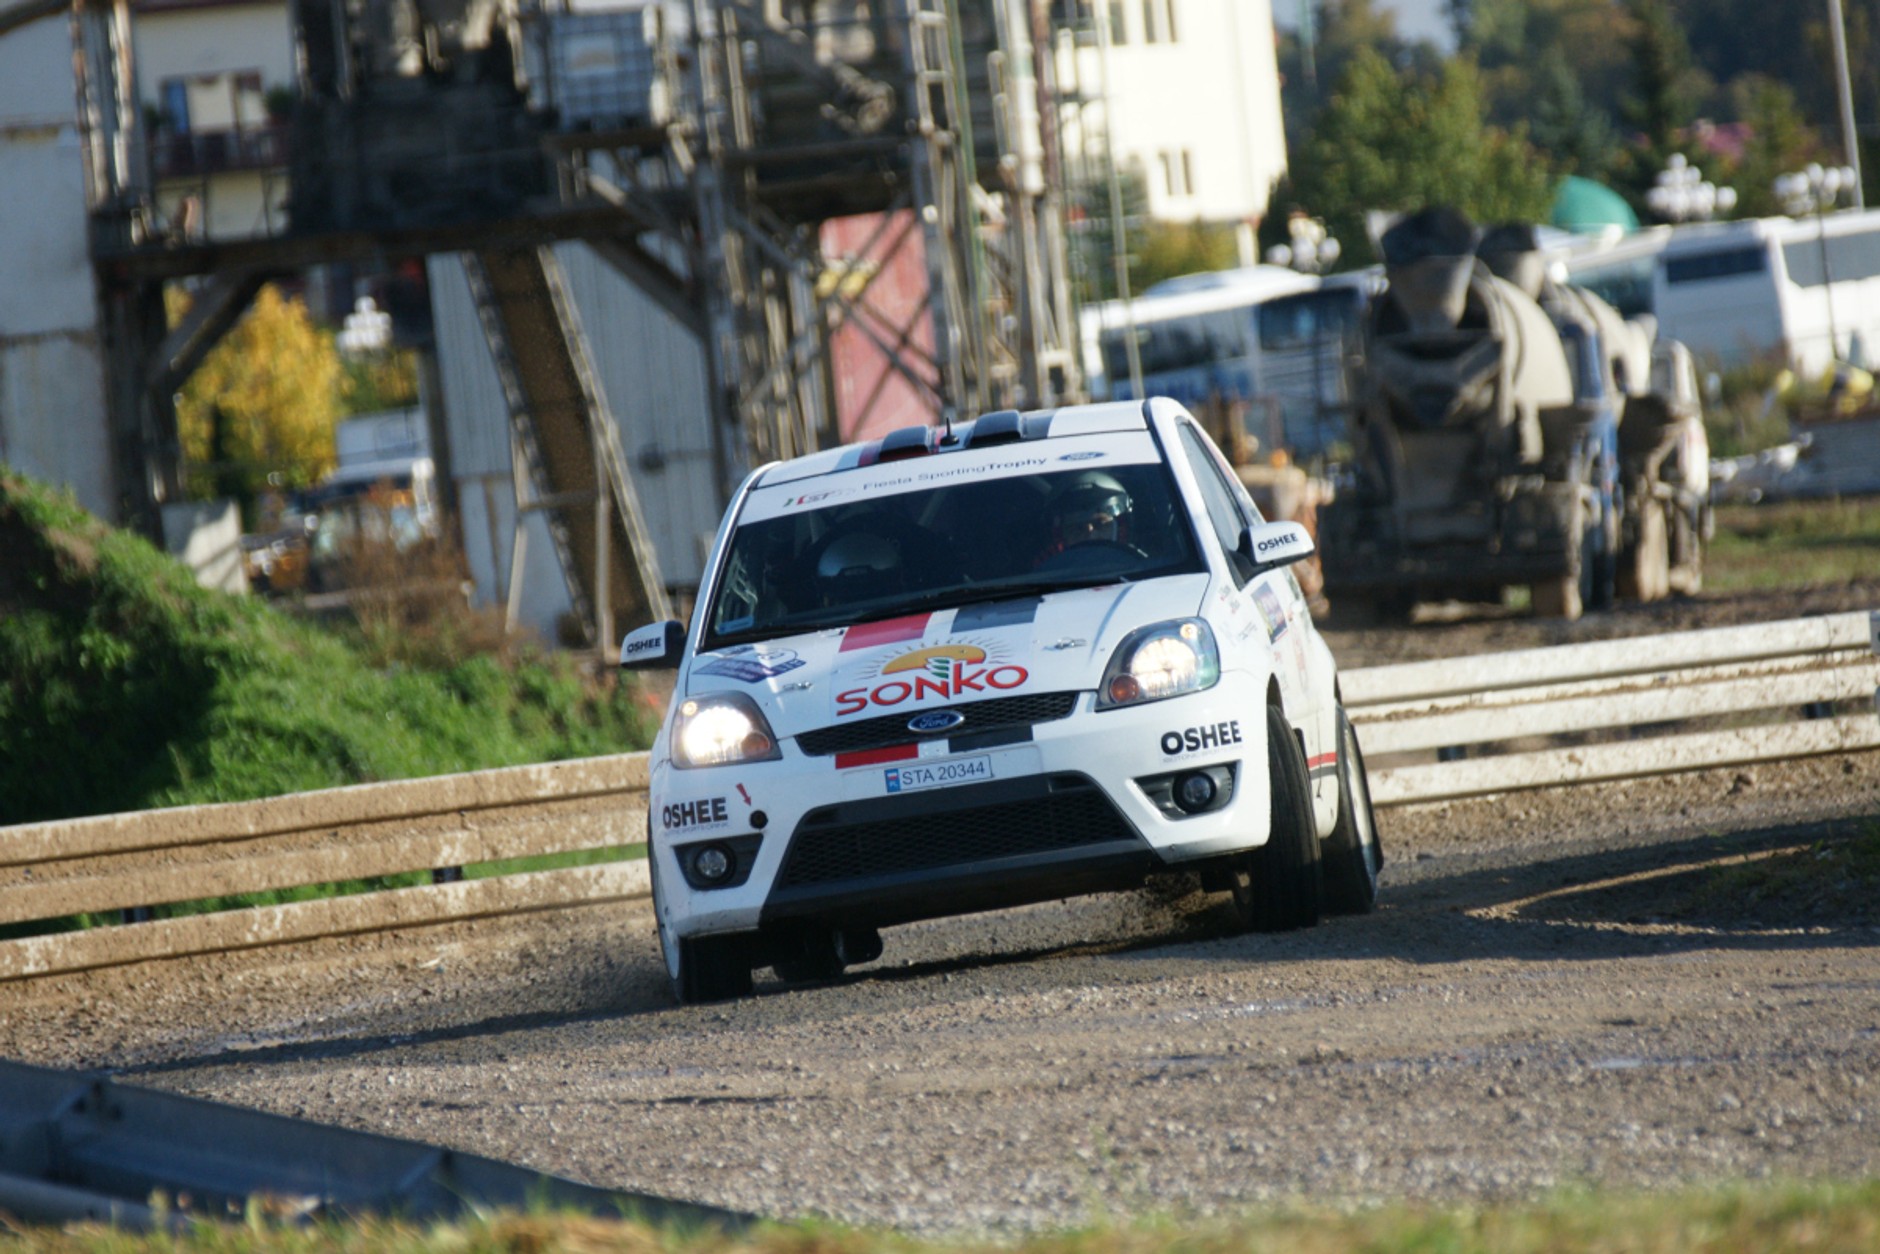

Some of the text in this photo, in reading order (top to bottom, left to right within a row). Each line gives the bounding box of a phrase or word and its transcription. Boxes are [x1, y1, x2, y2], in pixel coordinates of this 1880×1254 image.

[863, 457, 1047, 490] Fiesta SportingTrophy
[1257, 533, 1298, 552] OSHEE
[626, 637, 662, 653] OSHEE
[835, 663, 1028, 716] SONKO
[919, 714, 949, 729] Ford
[1161, 720, 1242, 755] OSHEE
[902, 761, 985, 785] STA 20344
[663, 797, 728, 829] OSHEE
